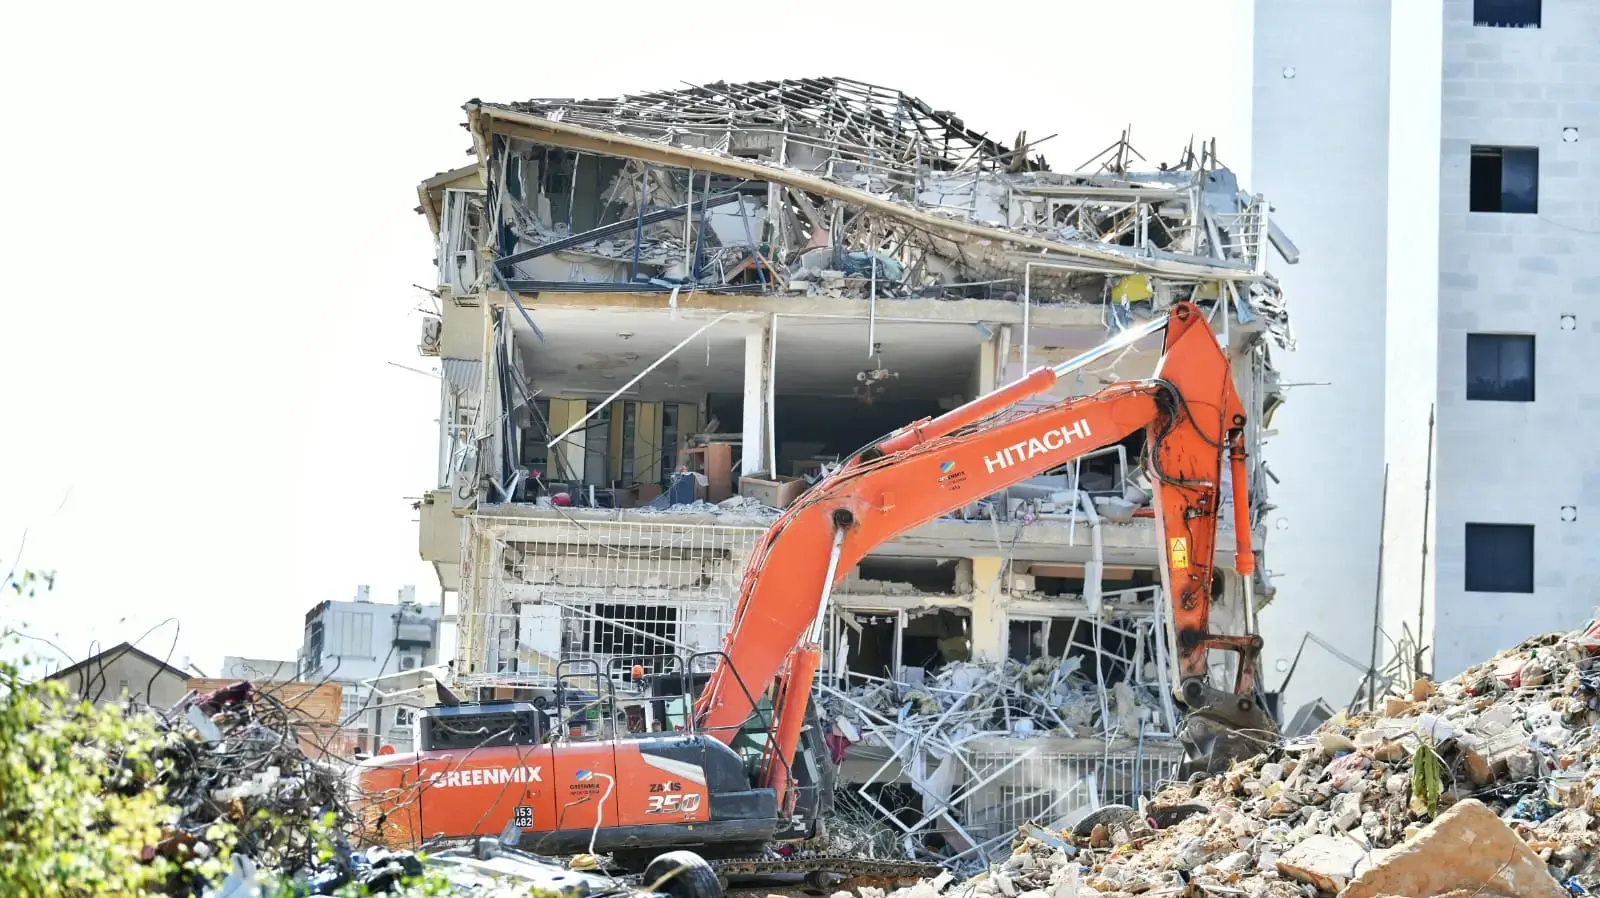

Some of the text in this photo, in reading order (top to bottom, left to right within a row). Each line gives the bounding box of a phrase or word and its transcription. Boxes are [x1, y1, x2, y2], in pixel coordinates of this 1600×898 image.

[983, 418, 1092, 474] HITACHI
[430, 766, 542, 788] GREENMIX
[649, 781, 682, 793] ZAXIS
[515, 807, 532, 816] 153
[644, 793, 701, 815] 350
[515, 817, 532, 827] 482
